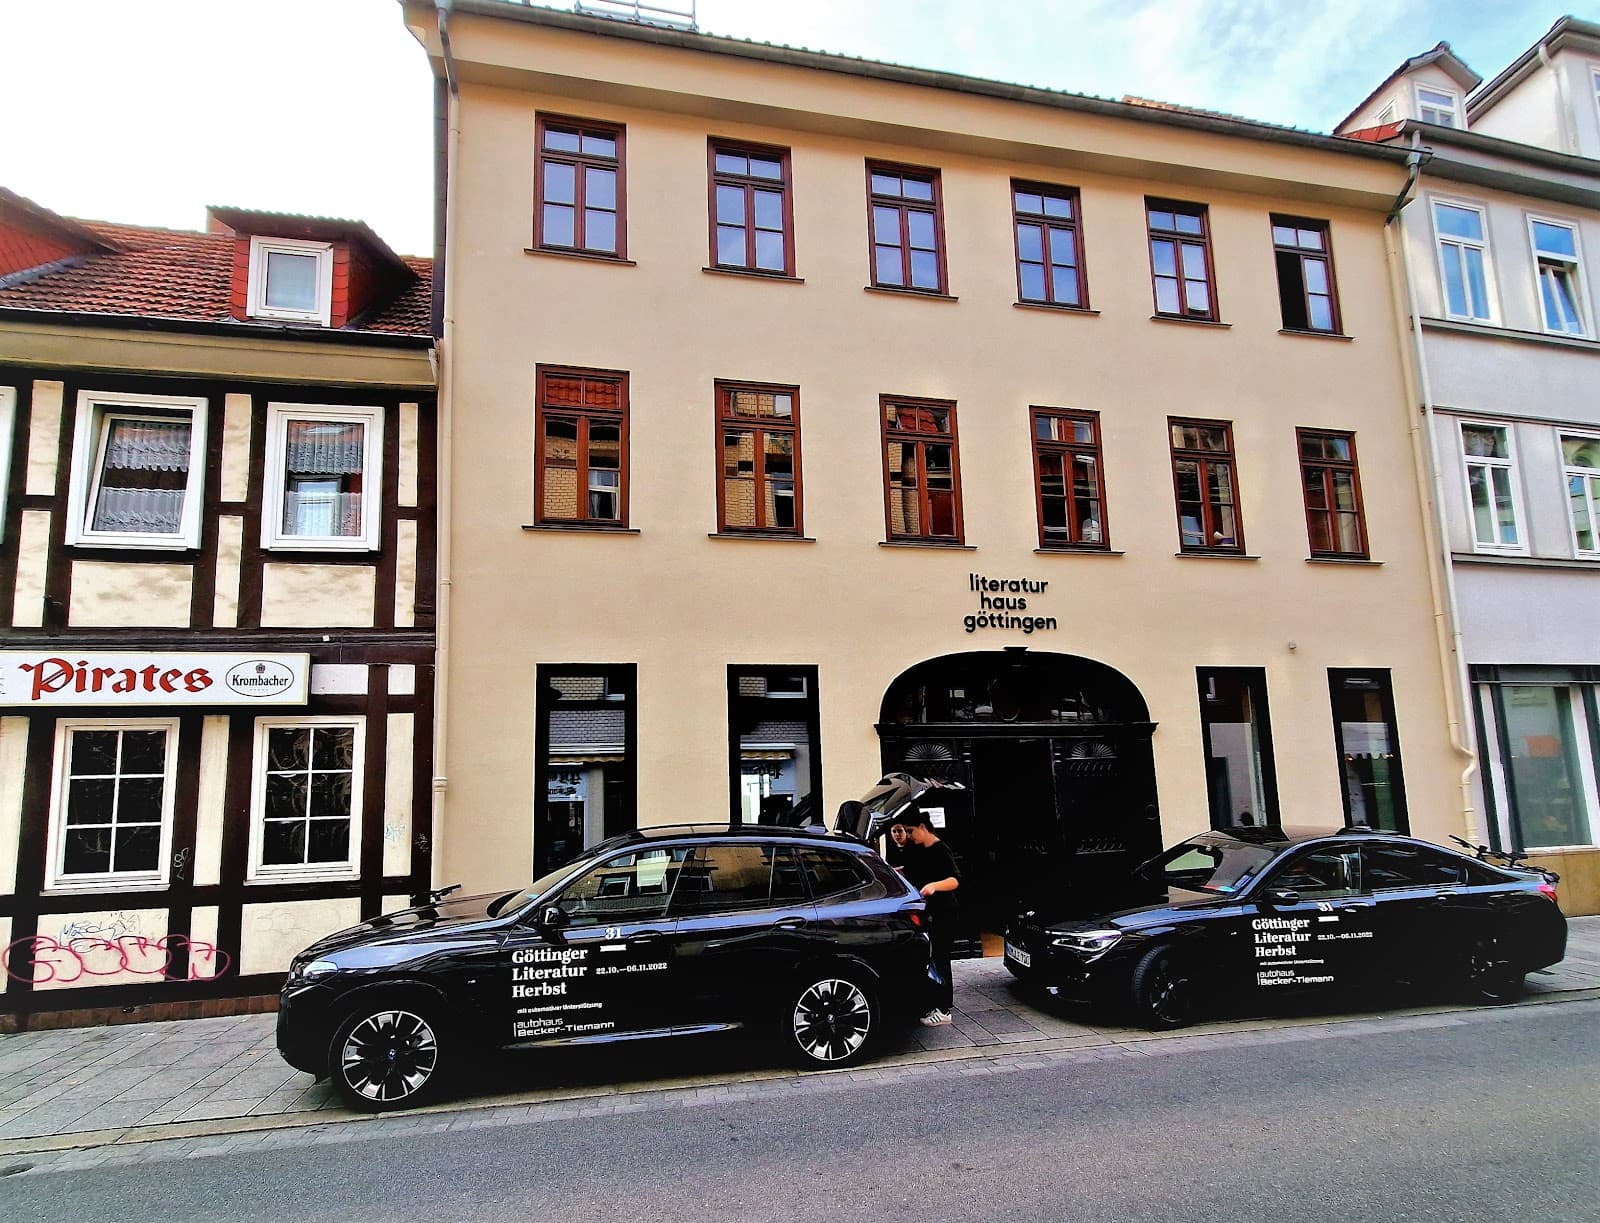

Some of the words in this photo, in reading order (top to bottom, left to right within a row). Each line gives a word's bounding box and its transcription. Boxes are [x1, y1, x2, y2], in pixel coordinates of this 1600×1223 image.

[969, 573, 1049, 594] literatur
[980, 592, 1027, 610] haus
[963, 611, 1057, 634] göttingen
[18, 657, 214, 701] Pirates
[232, 674, 289, 687] Krombacher
[1317, 902, 1333, 912] 31
[1252, 918, 1310, 931] Göttinger
[605, 927, 622, 940] 31
[1254, 932, 1311, 944] Literatur
[512, 948, 588, 964] Göttinger
[1255, 945, 1297, 957] Herbst
[512, 965, 588, 981] Literatur
[1259, 969, 1295, 978] autohaus
[1260, 975, 1335, 986] Becker-Tiemann
[512, 982, 567, 998] Herbst
[517, 1018, 563, 1029] autohaus
[517, 1021, 615, 1037] Becker-Tiemann
